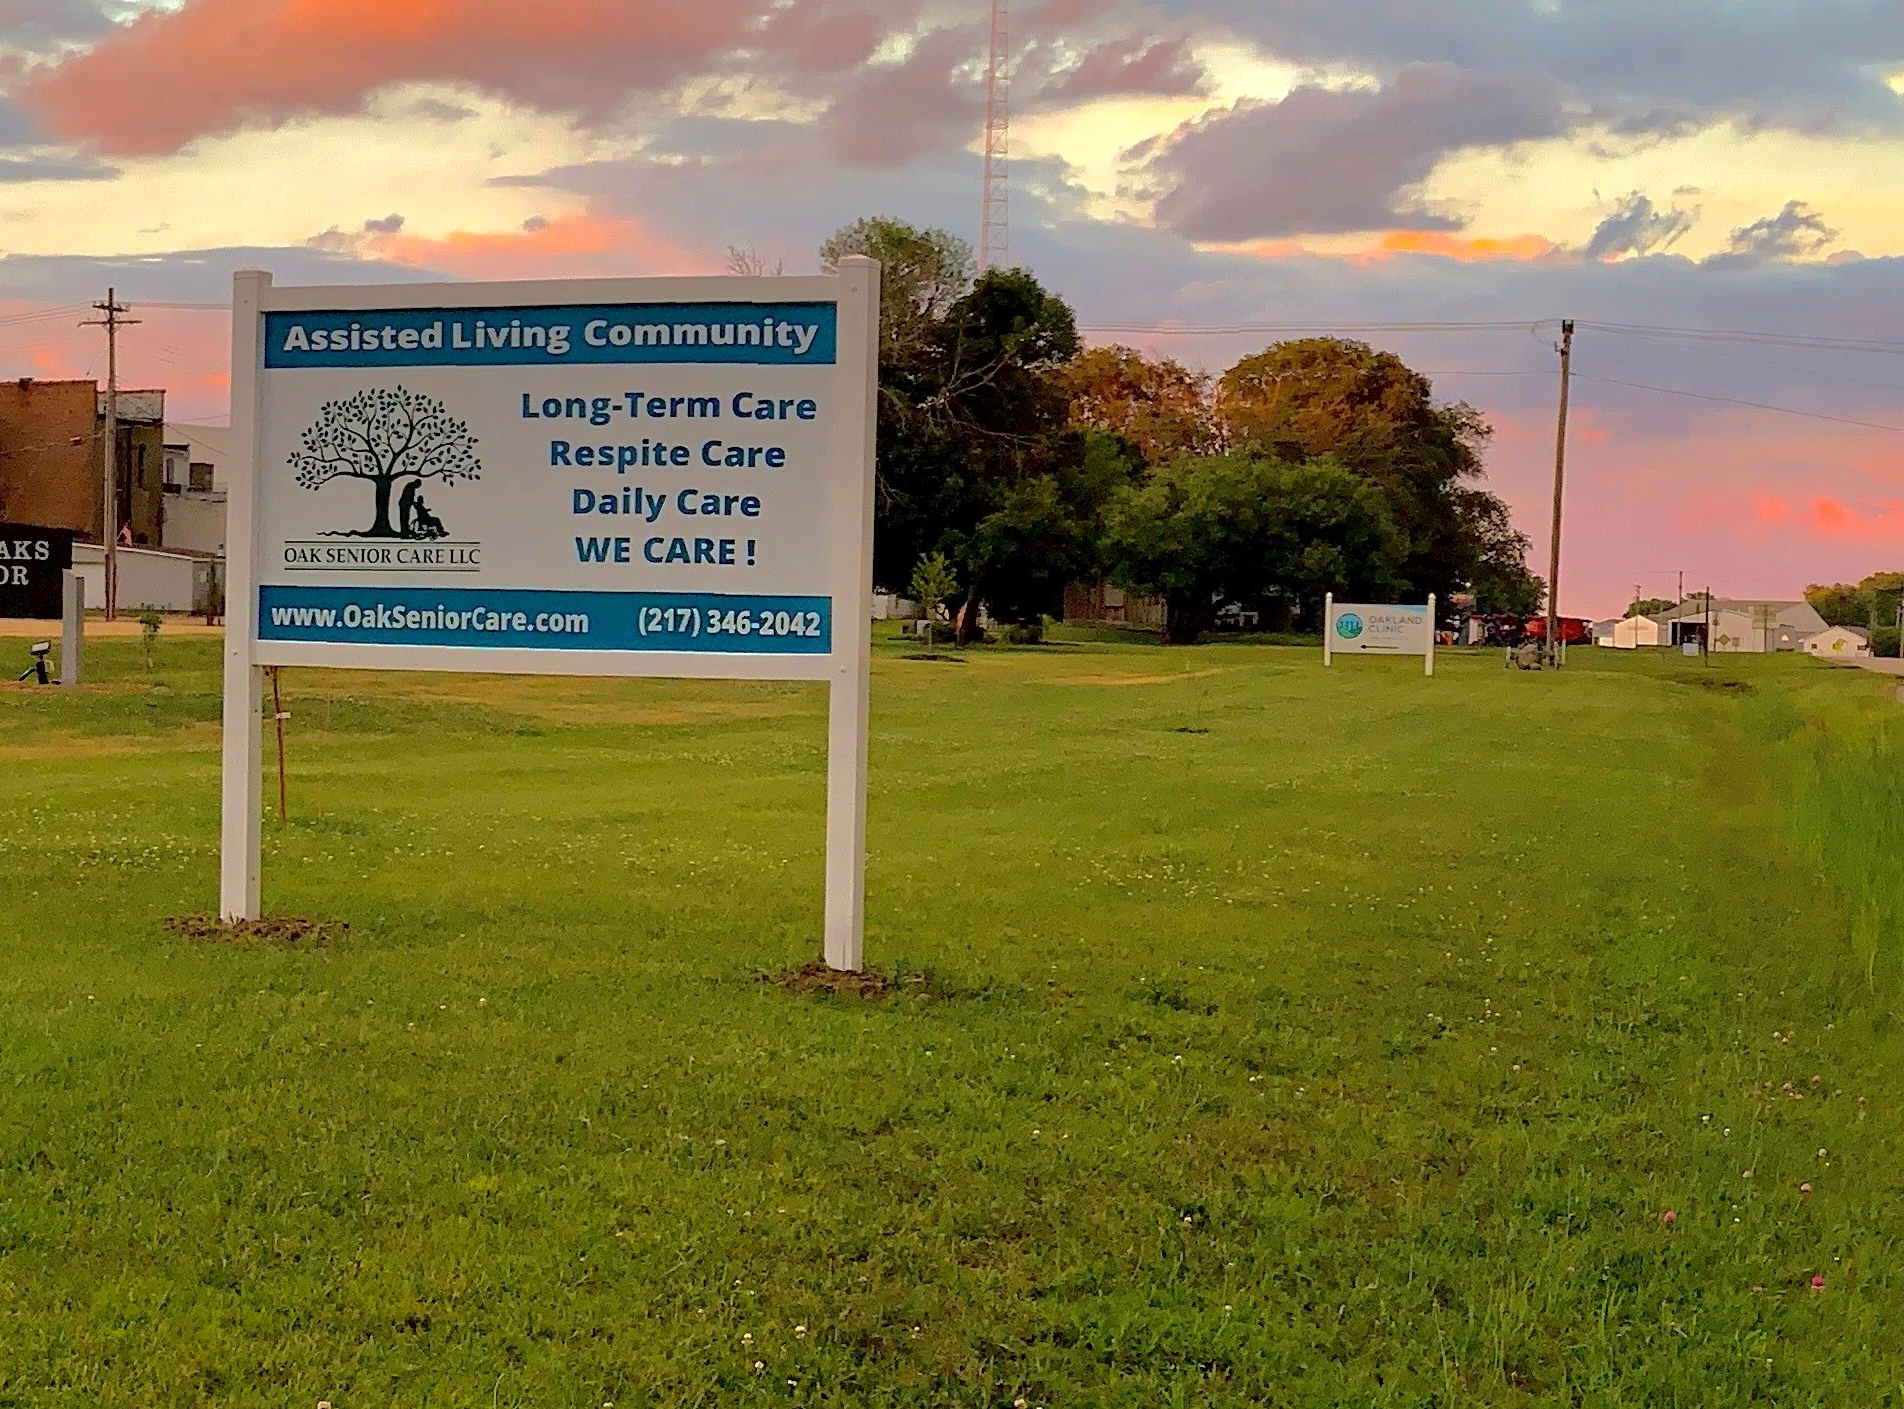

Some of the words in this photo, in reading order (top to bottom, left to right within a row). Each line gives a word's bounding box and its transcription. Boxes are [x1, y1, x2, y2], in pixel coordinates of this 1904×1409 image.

[283, 321, 443, 352] Assisted
[451, 319, 571, 354] Living
[583, 317, 819, 354] Community
[522, 392, 721, 426] Long-Term
[732, 392, 818, 420] Care
[550, 438, 691, 475] Respite
[701, 440, 787, 468] Care
[572, 487, 667, 523] Daily
[677, 489, 762, 517] Care
[284, 547, 322, 563] OAK
[326, 547, 392, 564] SENIOR
[396, 548, 445, 564] CARE
[449, 549, 481, 565] LLC
[575, 536, 631, 563] WE
[644, 537, 736, 565] CARE
[746, 539, 757, 566] !
[270, 602, 590, 635] www.OakSeniorCare.com
[637, 605, 701, 639] (217)
[706, 608, 822, 638] 346-2042
[1367, 615, 1423, 625] OAKLAND
[1367, 625, 1405, 634] CLINIC
